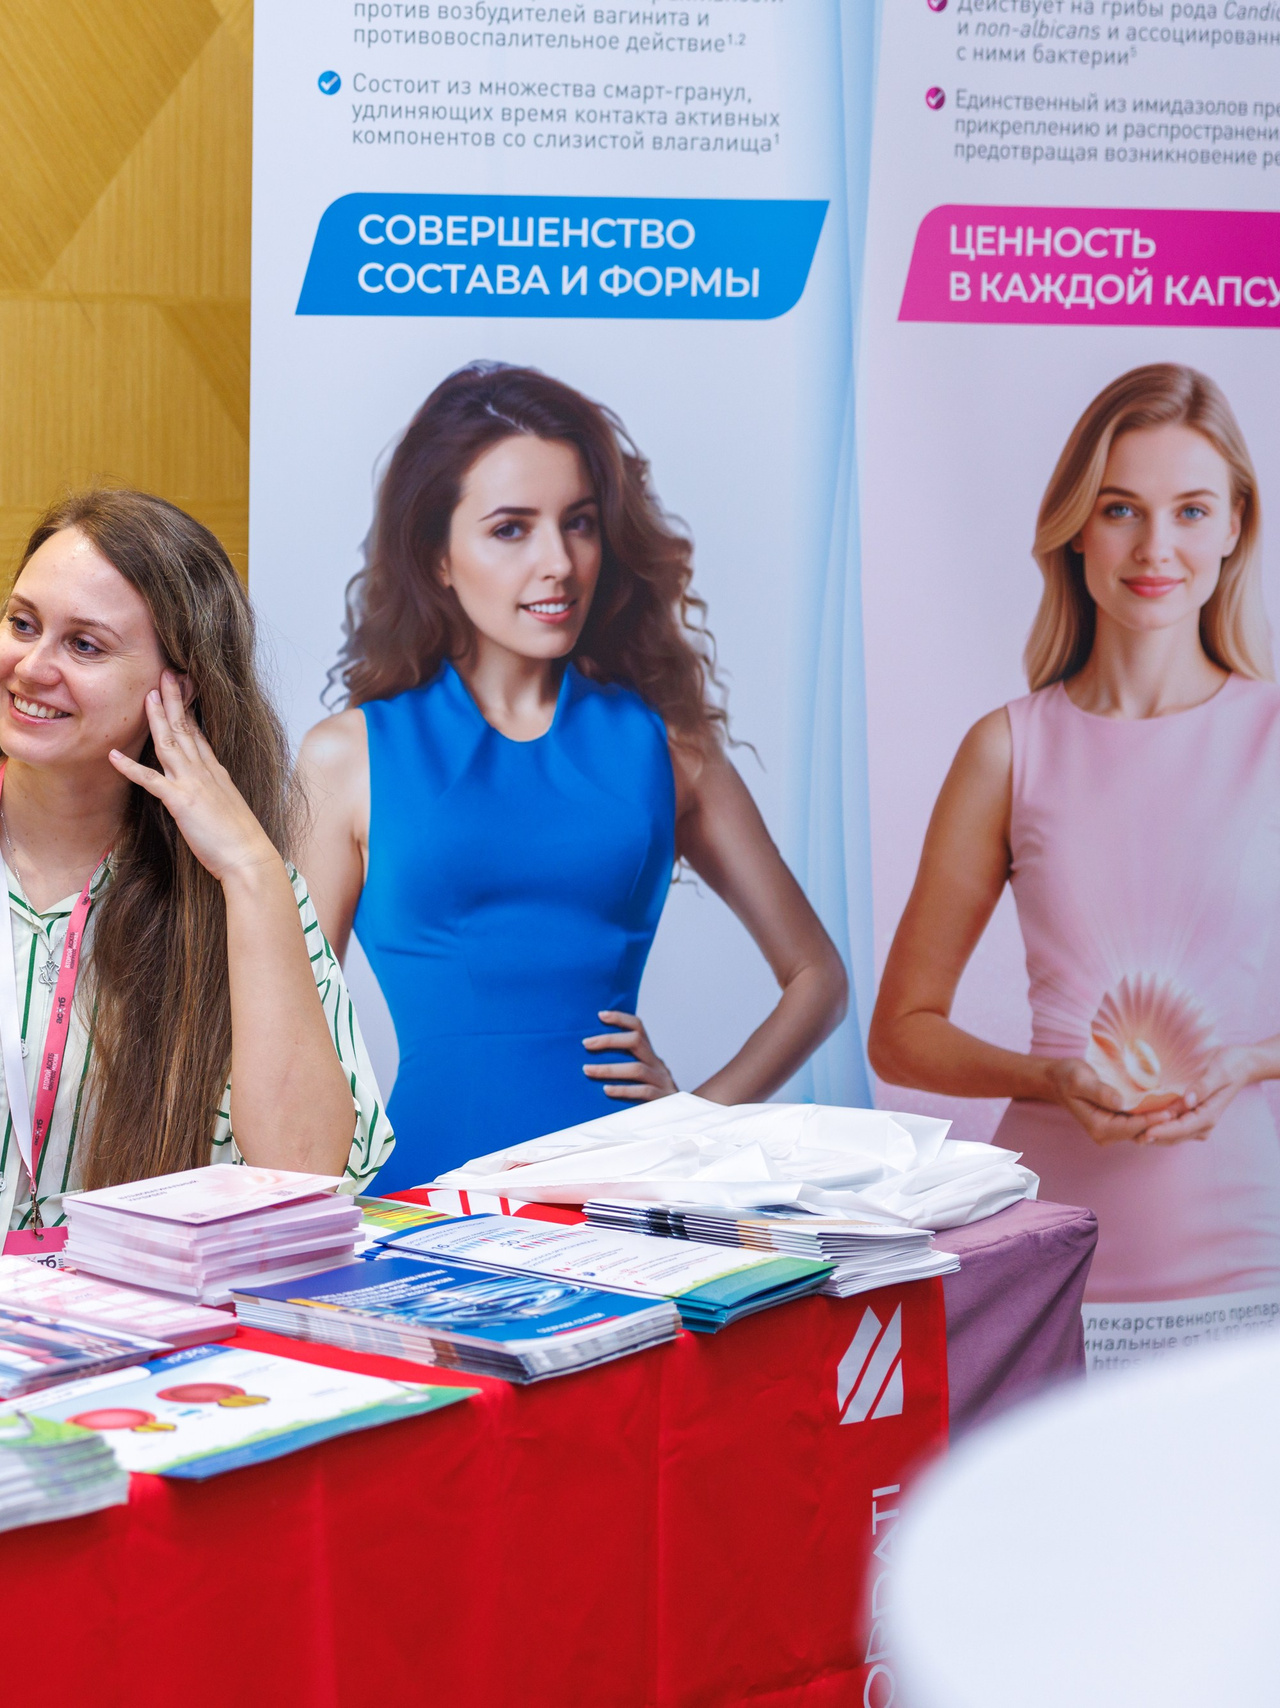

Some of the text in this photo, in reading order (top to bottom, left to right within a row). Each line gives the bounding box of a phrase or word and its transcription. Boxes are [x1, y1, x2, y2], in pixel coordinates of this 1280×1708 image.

[355, 1, 709, 26] против возбудителей вагинита и
[957, 0, 1217, 22] Действует на грибы рода
[354, 29, 619, 50] противовоспалительное
[958, 22, 968, 35] и
[975, 19, 1100, 40] non-albicans
[1108, 27, 1119, 40] и
[956, 46, 966, 61] с
[973, 48, 1025, 62] ними
[353, 73, 751, 106] Состоит из множества смарт-гранул,
[956, 88, 1098, 112] Единственный
[1105, 98, 1126, 113] из
[1133, 99, 1248, 116] имидазолов
[352, 104, 779, 127] удлиняющих время контакта активных
[353, 130, 495, 147] компонентов
[503, 133, 525, 147] со
[534, 131, 644, 149] слизистой
[955, 119, 1279, 144] прикреплению и распространени
[955, 143, 1098, 164] предотвращая
[1105, 147, 1257, 165] возникновение
[359, 214, 695, 249] СОВЕРШЕНСТВО
[950, 224, 1156, 261] ЦЕННОСТЬ
[358, 262, 759, 297] СОСТАВА И ФОРМЫ
[950, 267, 1280, 309] В КАЖДОЙ КАПСУ
[63, 948, 74, 968] ВТОРОЙ
[40, 1069, 52, 1090] ВТОРОЙ
[1086, 1309, 1226, 1333] лекарственного
